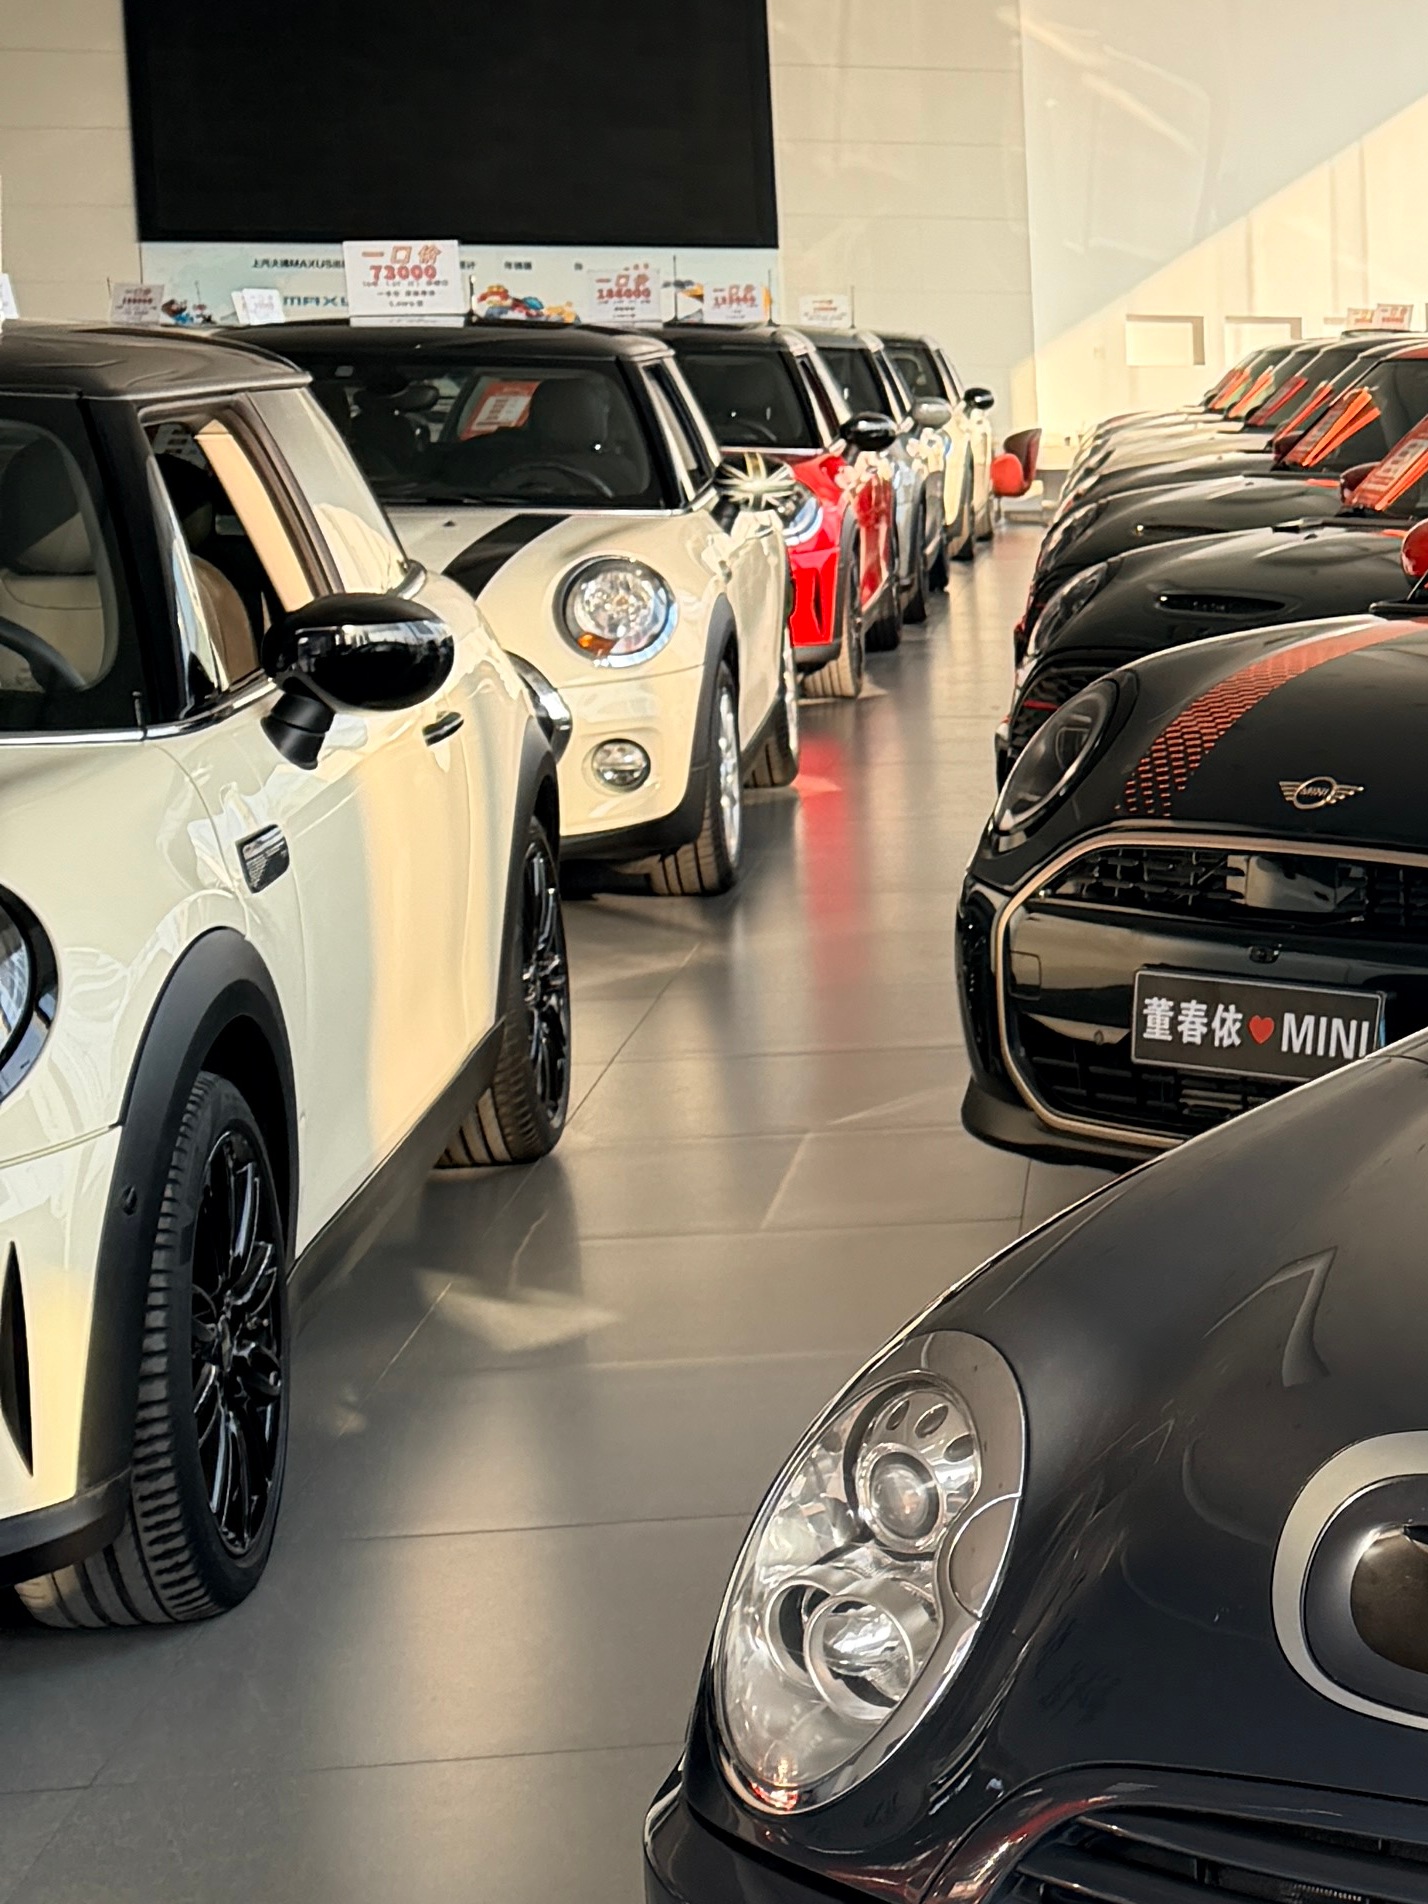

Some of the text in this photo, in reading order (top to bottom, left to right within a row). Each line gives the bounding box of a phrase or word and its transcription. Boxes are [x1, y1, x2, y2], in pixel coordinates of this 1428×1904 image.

[361, 244, 442, 265] 一口价
[1142, 996, 1370, 1060] 董春依 MINI
